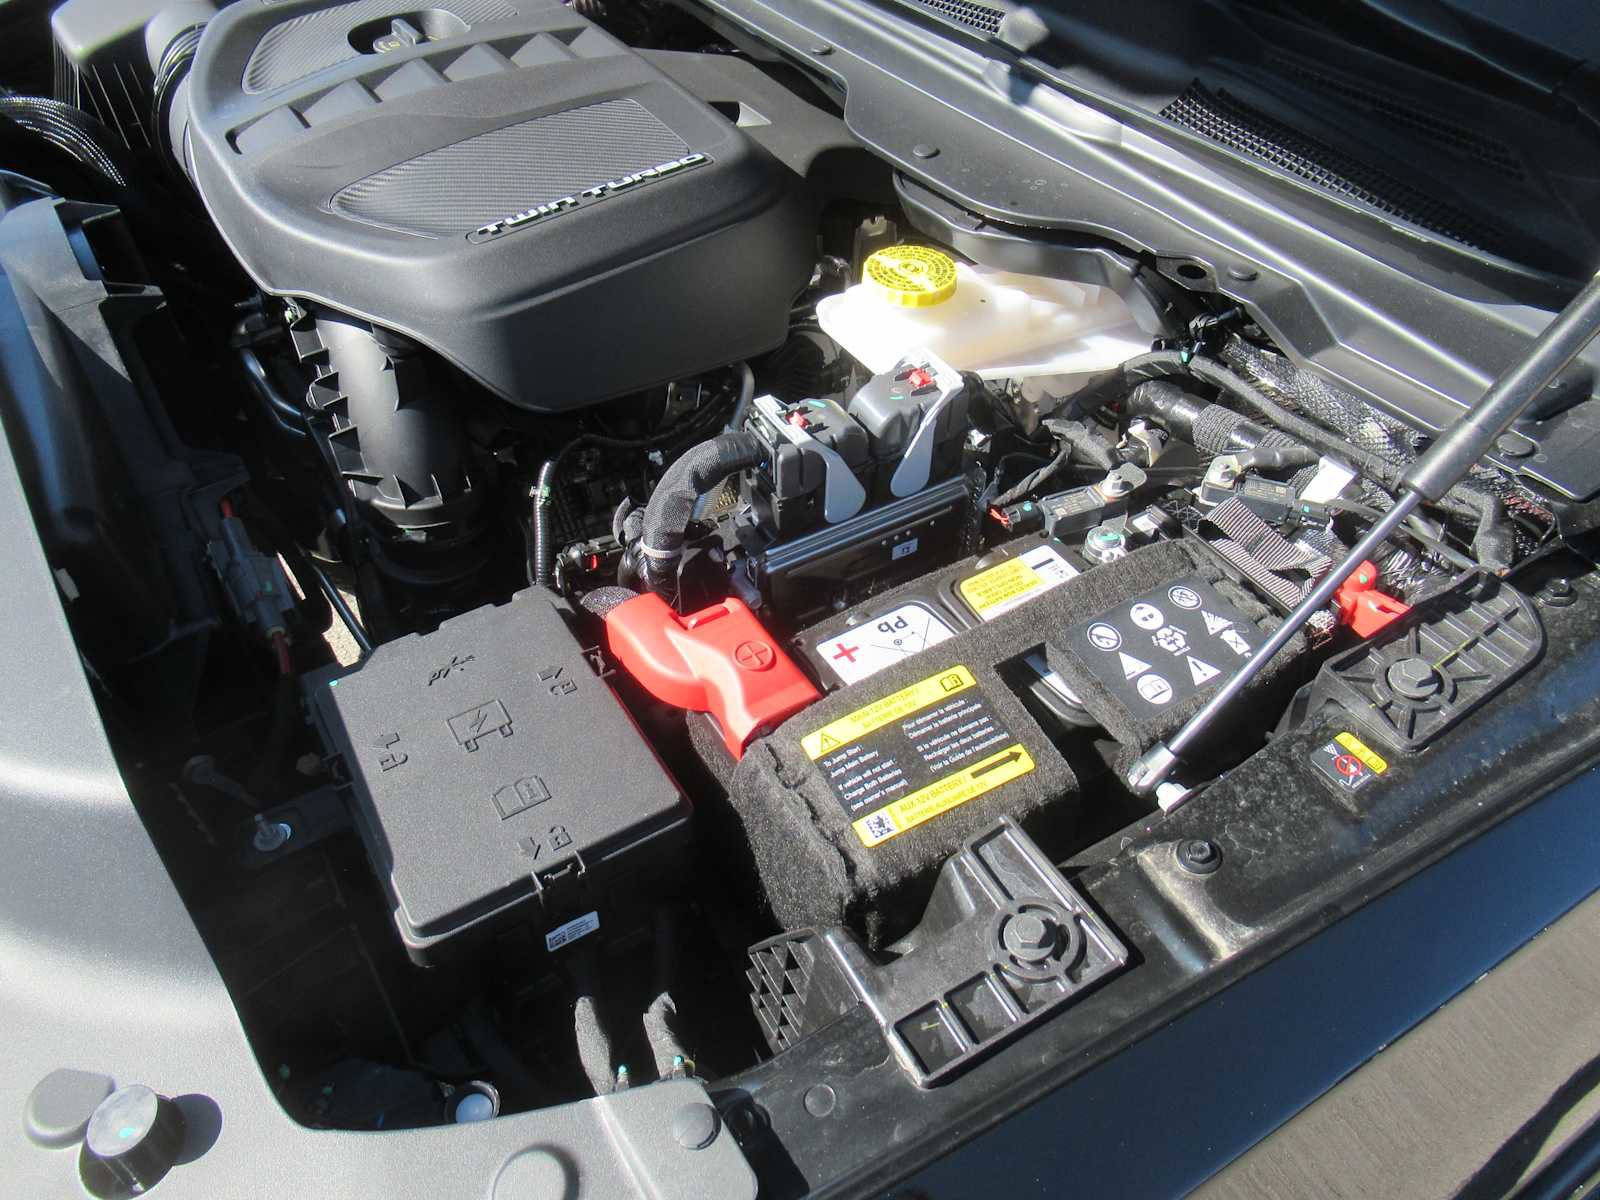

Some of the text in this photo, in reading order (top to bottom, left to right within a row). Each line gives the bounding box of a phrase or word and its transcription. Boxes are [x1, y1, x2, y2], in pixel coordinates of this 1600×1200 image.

[477, 152, 707, 236] TWIN TURBO
[878, 616, 908, 633] Pb
[883, 689, 915, 707] BATTERY
[938, 713, 957, 725] batterie
[957, 702, 982, 717] principale
[829, 750, 879, 777] Jump Main Battery
[830, 753, 847, 764] Jump
[948, 751, 965, 763] Guide
[842, 775, 862, 787] vehicle
[860, 769, 873, 779] will
[870, 765, 882, 774] not
[843, 768, 902, 800] Charge Both Batteries
[899, 800, 916, 812] AUX
[915, 793, 930, 804] 12V
[929, 778, 963, 798] BATTERY
